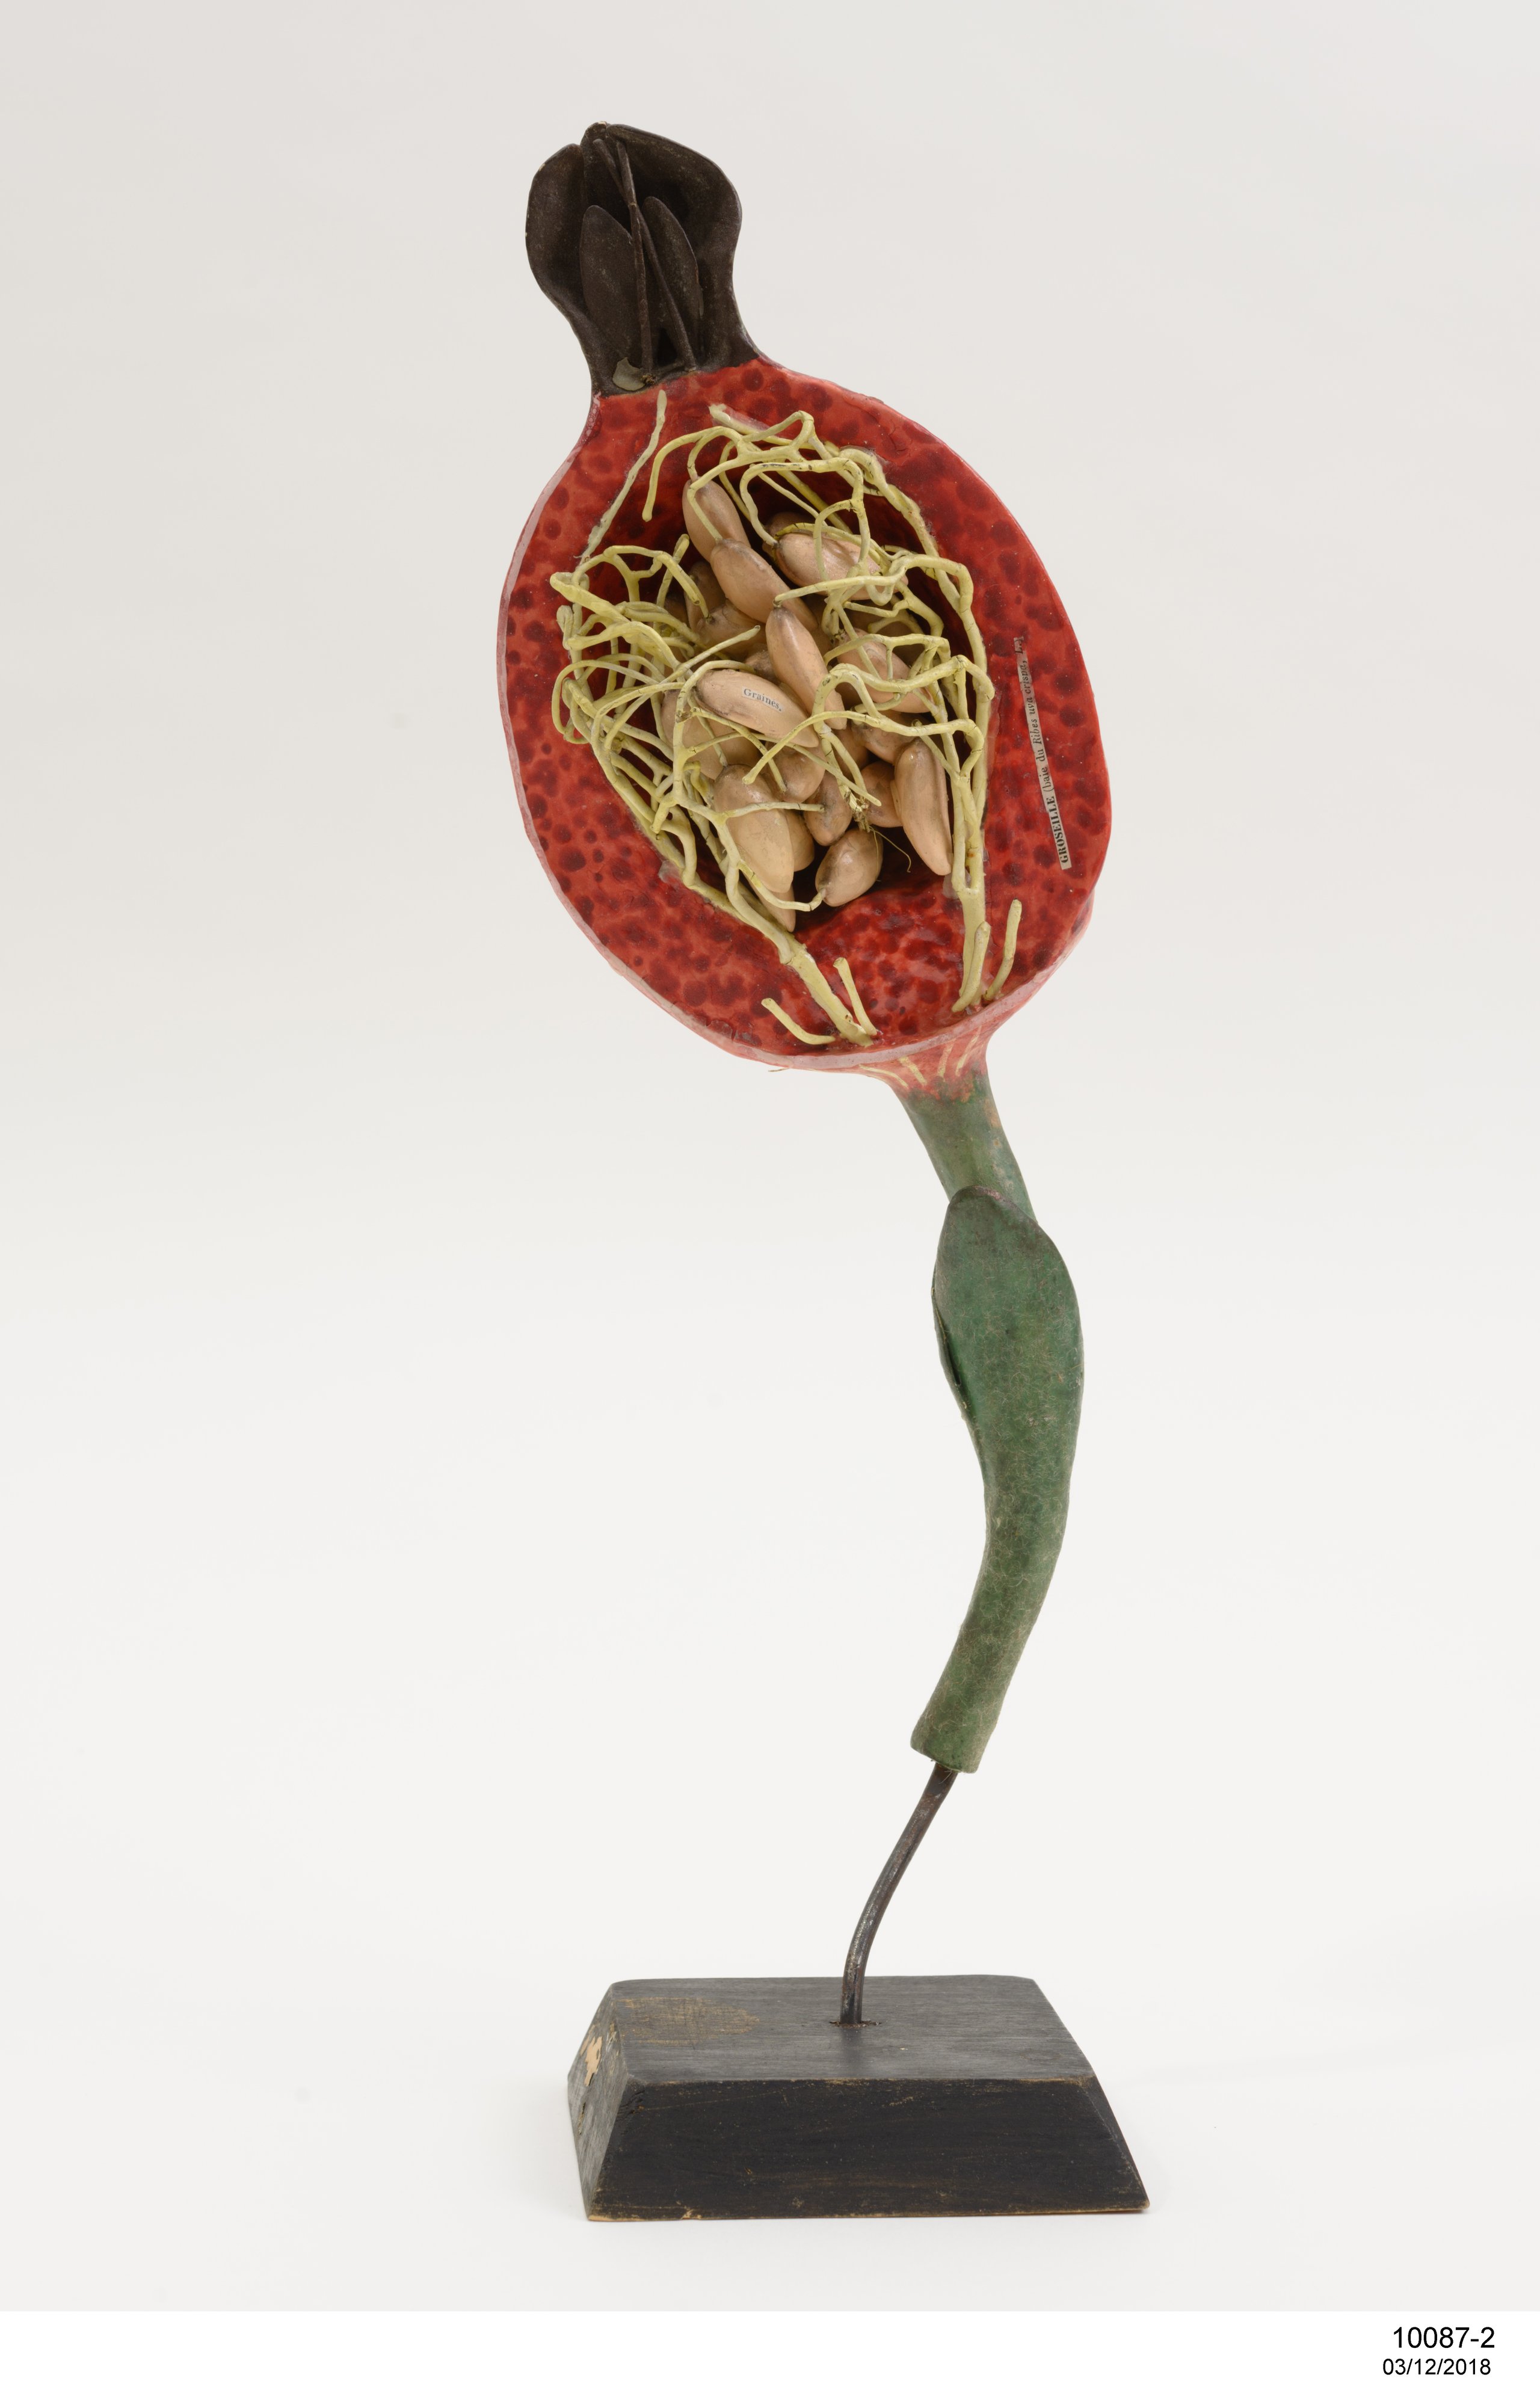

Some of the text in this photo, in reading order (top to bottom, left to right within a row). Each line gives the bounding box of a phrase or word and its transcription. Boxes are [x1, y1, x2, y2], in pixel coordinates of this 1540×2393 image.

[1020, 660, 1031, 694] crispa,
[744, 688, 781, 712] Graines.
[1026, 697, 1035, 715] uva
[1029, 719, 1042, 745] Ribes
[1035, 748, 1046, 762] du
[1042, 766, 1055, 792] (baie
[1046, 796, 1068, 863] GROSEILLE
